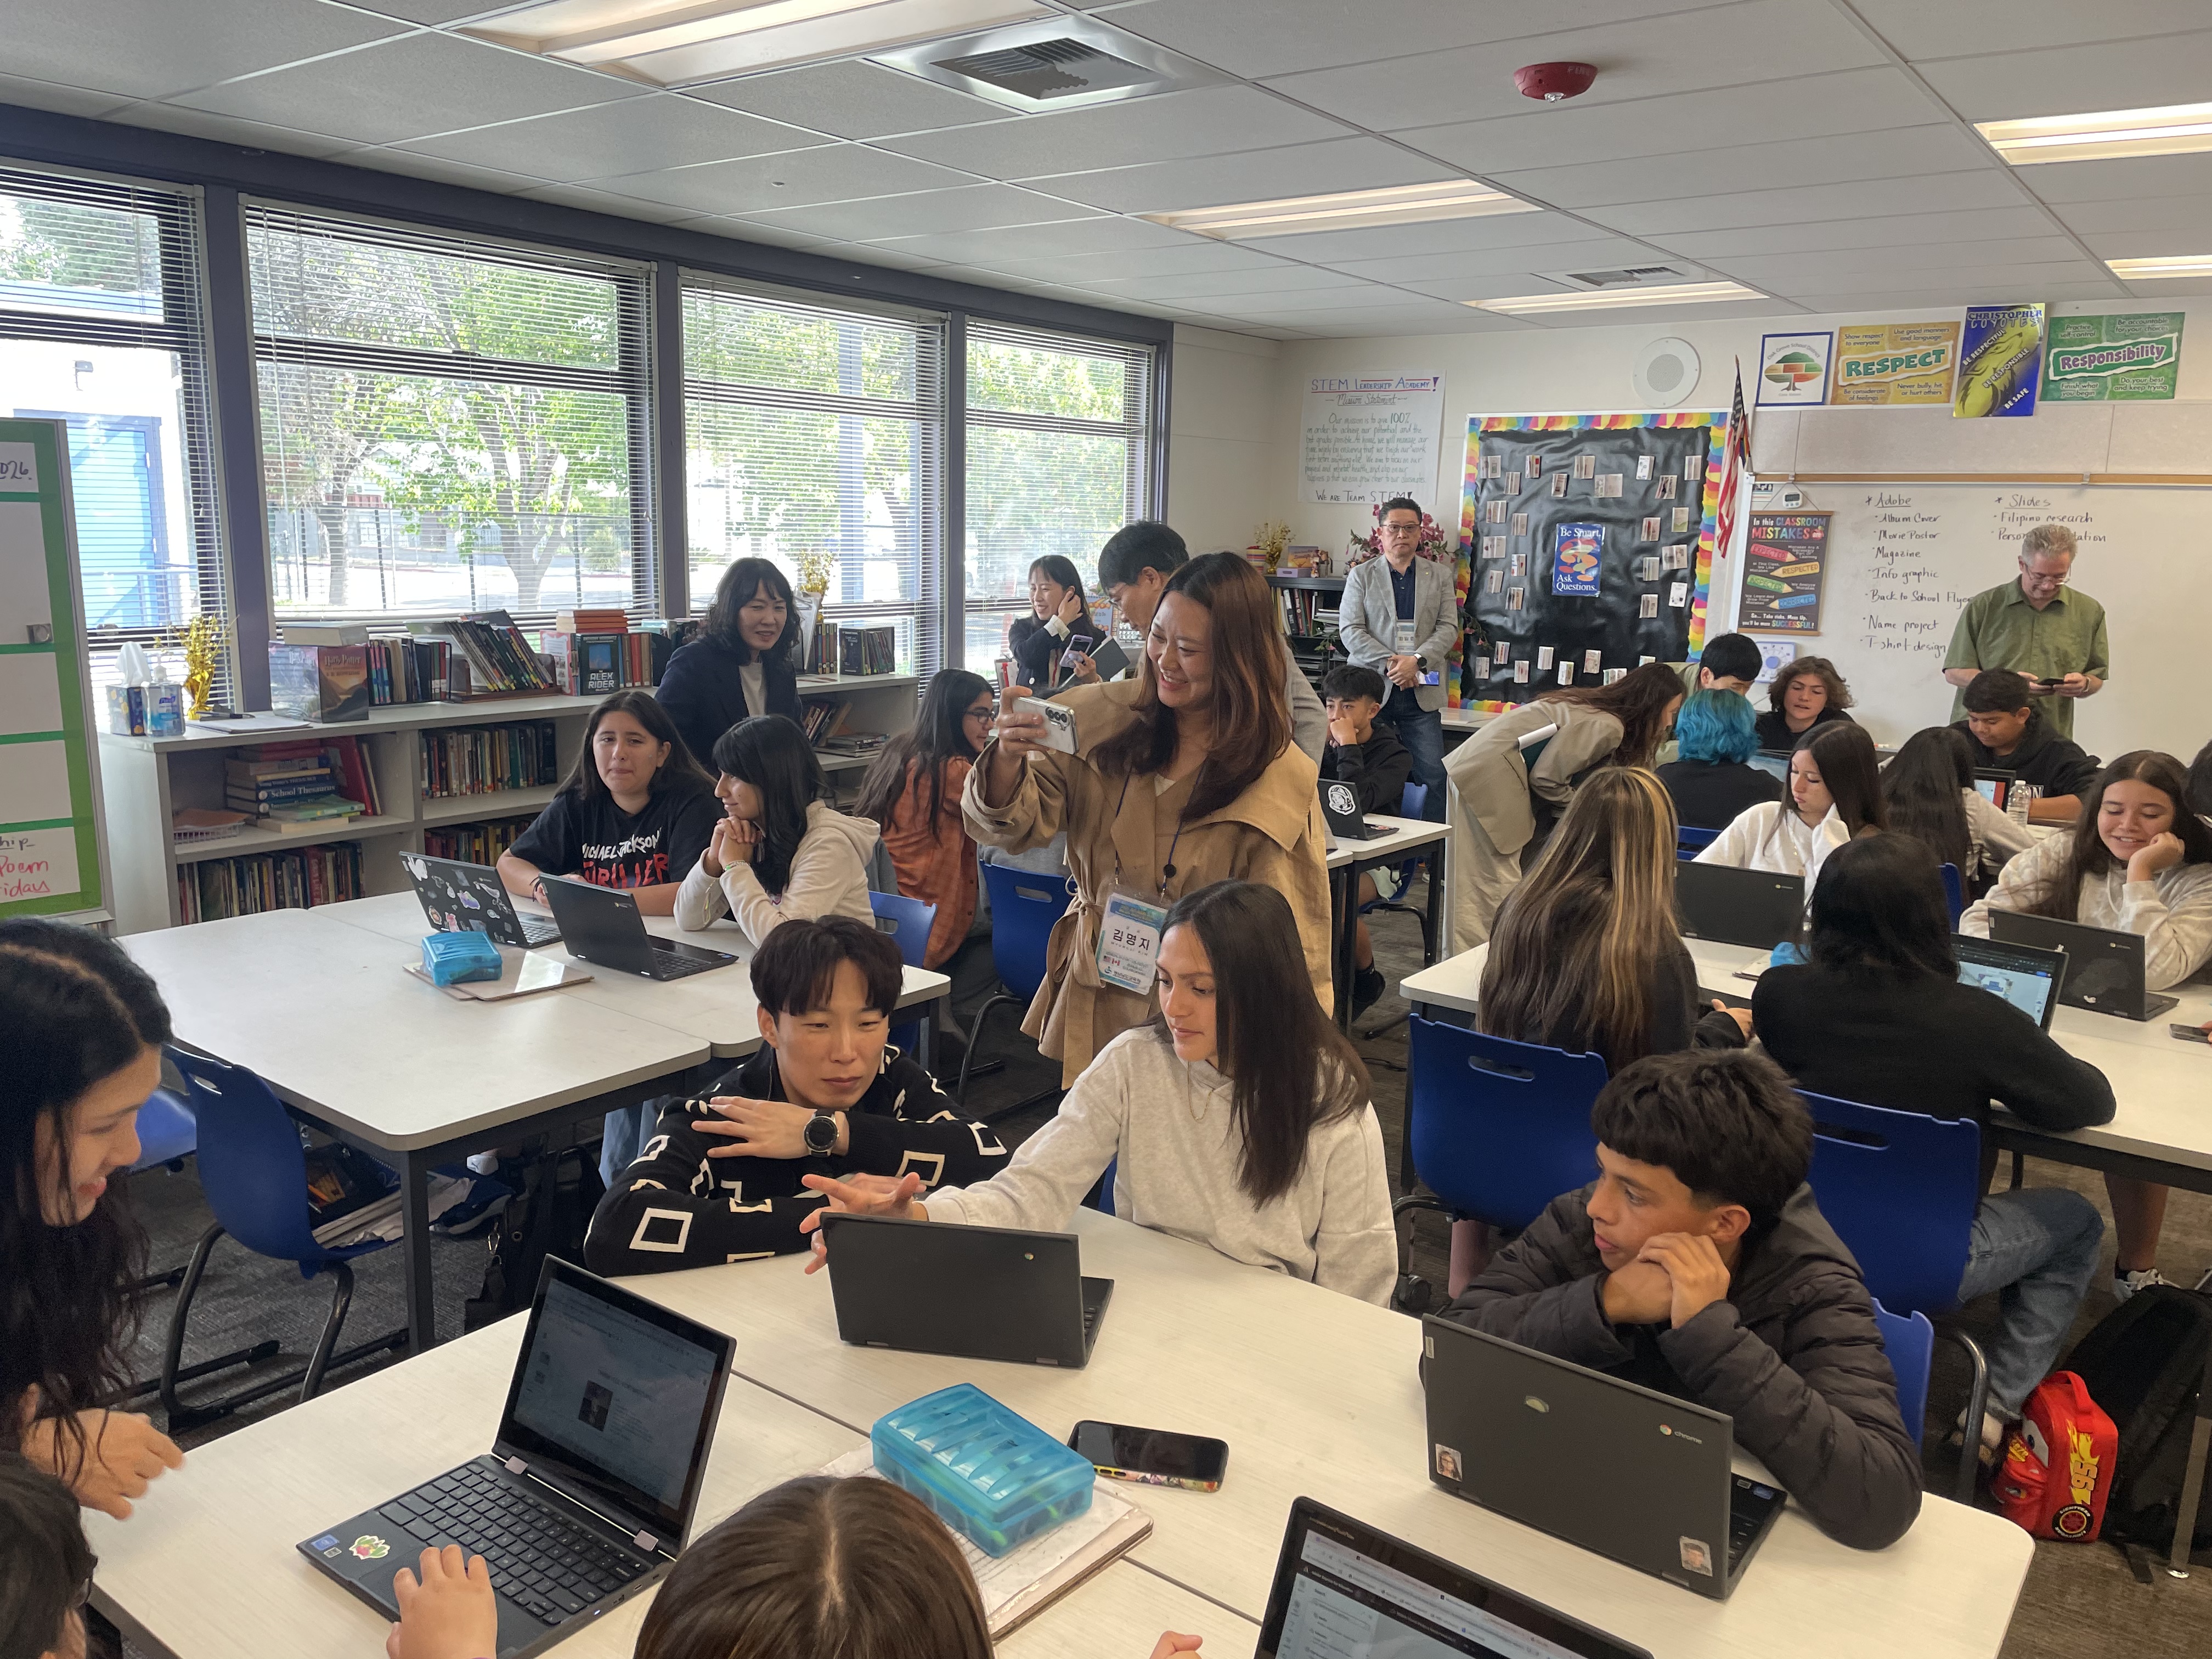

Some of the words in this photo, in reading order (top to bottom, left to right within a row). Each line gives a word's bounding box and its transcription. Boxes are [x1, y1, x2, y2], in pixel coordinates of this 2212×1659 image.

[1968, 310, 2042, 320] CHRISTOPHER
[1971, 317, 2039, 329] COYOTES
[1962, 357, 1972, 366] BE
[1971, 329, 2006, 359] RESPECTFUL
[1846, 348, 1945, 377] RESPECT
[2061, 345, 2165, 369] Responsibility
[1983, 379, 1992, 388] BE
[1991, 347, 2029, 382] RESPONSIBLE
[1312, 379, 1348, 391] STEM
[1355, 378, 1392, 390] LEADERSHIP
[1337, 393, 1362, 405] Mission
[2004, 400, 2013, 409] BE
[2012, 388, 2029, 403] SAFE
[1329, 413, 1342, 424] Our
[1391, 412, 1410, 424] 100%
[1314, 424, 1330, 433] order
[1332, 424, 1338, 433] to
[1374, 424, 1397, 437] potential
[1400, 423, 1412, 433] and
[1413, 423, 1422, 433] the
[1316, 489, 1327, 500] WE
[1343, 490, 1365, 501] TEAM
[1875, 493, 1911, 507] Adobe
[2009, 494, 2051, 507] Slides
[1753, 517, 1760, 526] In
[1762, 517, 1774, 526] this
[1776, 517, 1826, 527] CLASSROOM
[1878, 513, 1911, 522] Album
[1914, 512, 1941, 523] Cover
[2001, 512, 2040, 527] Filipino
[2046, 512, 2093, 523] research
[1560, 527, 1572, 537] Be
[1573, 528, 1601, 537] Smart.
[1751, 527, 1810, 539] MISTAKES
[1878, 530, 1906, 541] Movie
[1907, 530, 1941, 540] Poster
[1875, 546, 1921, 565] Magazine
[1782, 563, 1819, 574] RESPECTED
[1557, 574, 1572, 583] Ask
[1903, 567, 1939, 584] graphic
[1556, 582, 1597, 591] Questions.
[1870, 589, 1898, 602] Back
[1900, 592, 1908, 600] to
[1911, 590, 1939, 602] School
[1869, 614, 1896, 629] Name
[1904, 619, 1939, 634] project
[1914, 641, 1946, 658] design
[325, 656, 342, 666] Harry
[342, 654, 360, 667] Potter
[590, 672, 613, 681] ALEX
[588, 680, 614, 689] RIDER
[270, 788, 296, 797] School
[297, 785, 335, 794] Thesaurus
[617, 828, 662, 859] JACKSON
[1674, 1431, 1702, 1444] chrome
[2072, 1460, 2097, 1491] 95
